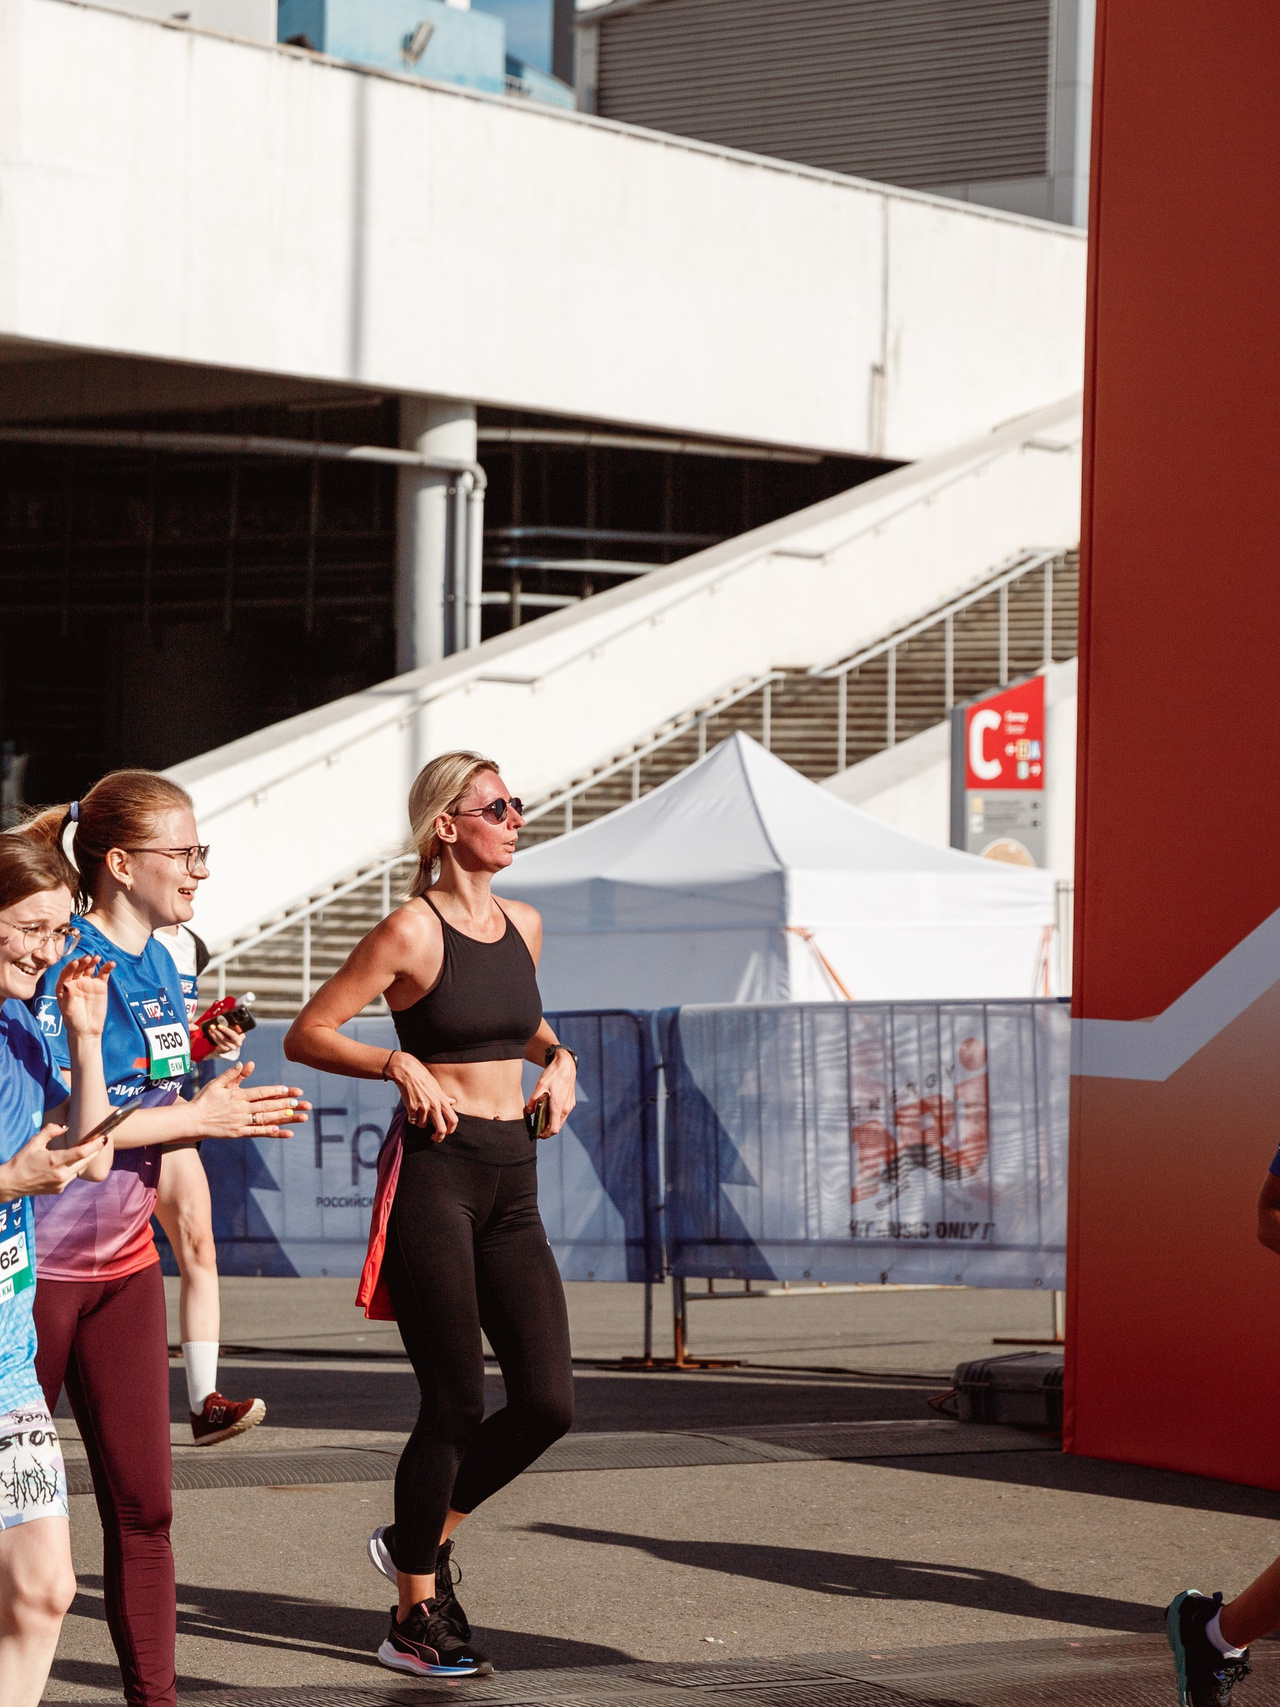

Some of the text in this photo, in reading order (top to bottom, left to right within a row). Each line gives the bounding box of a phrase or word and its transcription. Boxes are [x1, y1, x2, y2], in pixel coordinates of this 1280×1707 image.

[154, 1032, 183, 1051] 7830
[936, 1221, 979, 1239] ONLY
[2, 1285, 13, 1297] KM
